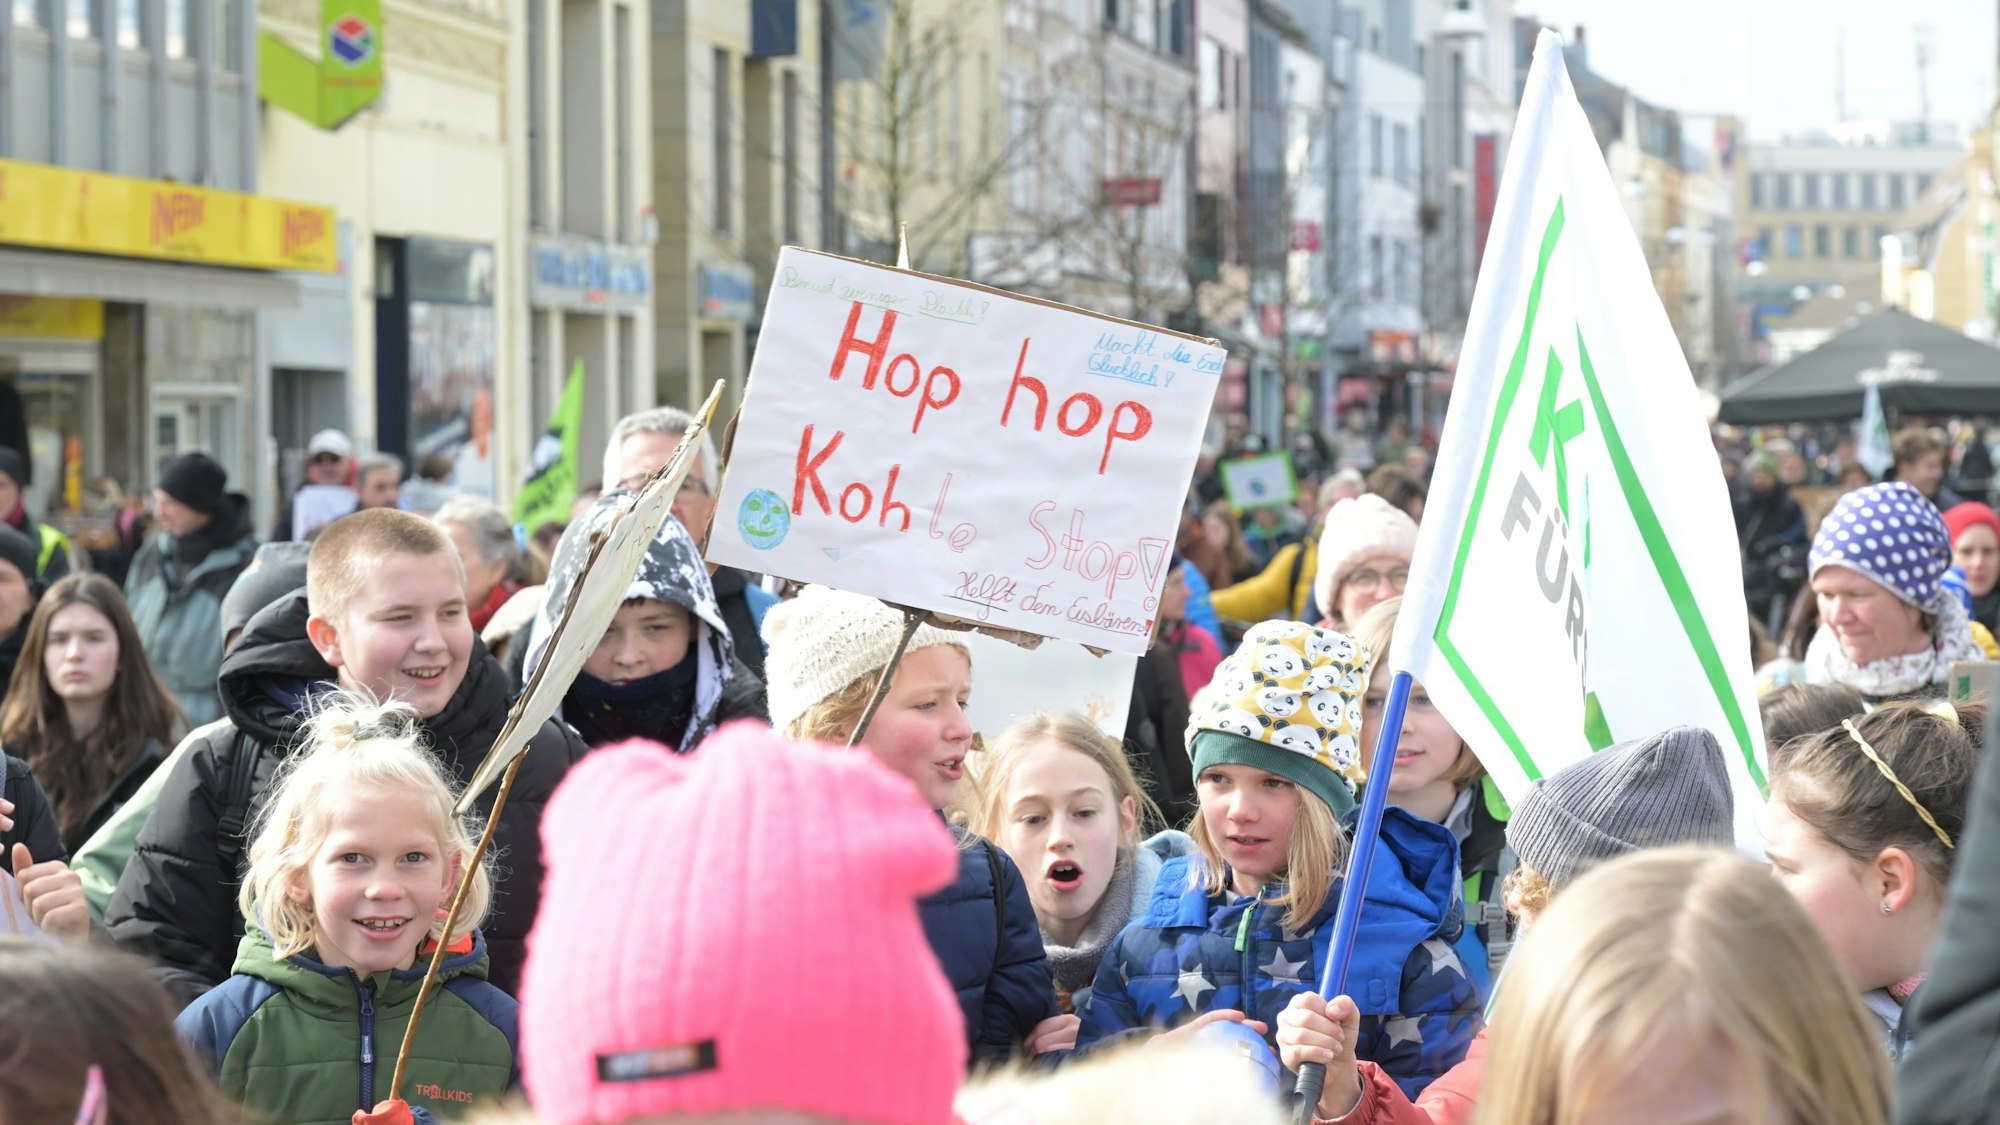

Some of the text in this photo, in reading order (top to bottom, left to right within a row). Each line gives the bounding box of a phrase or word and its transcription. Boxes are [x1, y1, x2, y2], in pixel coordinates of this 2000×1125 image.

[828, 300, 1153, 476] Hop hop
[791, 424, 978, 553] Kohle
[1019, 581, 1056, 616] den
[415, 1083, 473, 1104] TROLLKIDS
